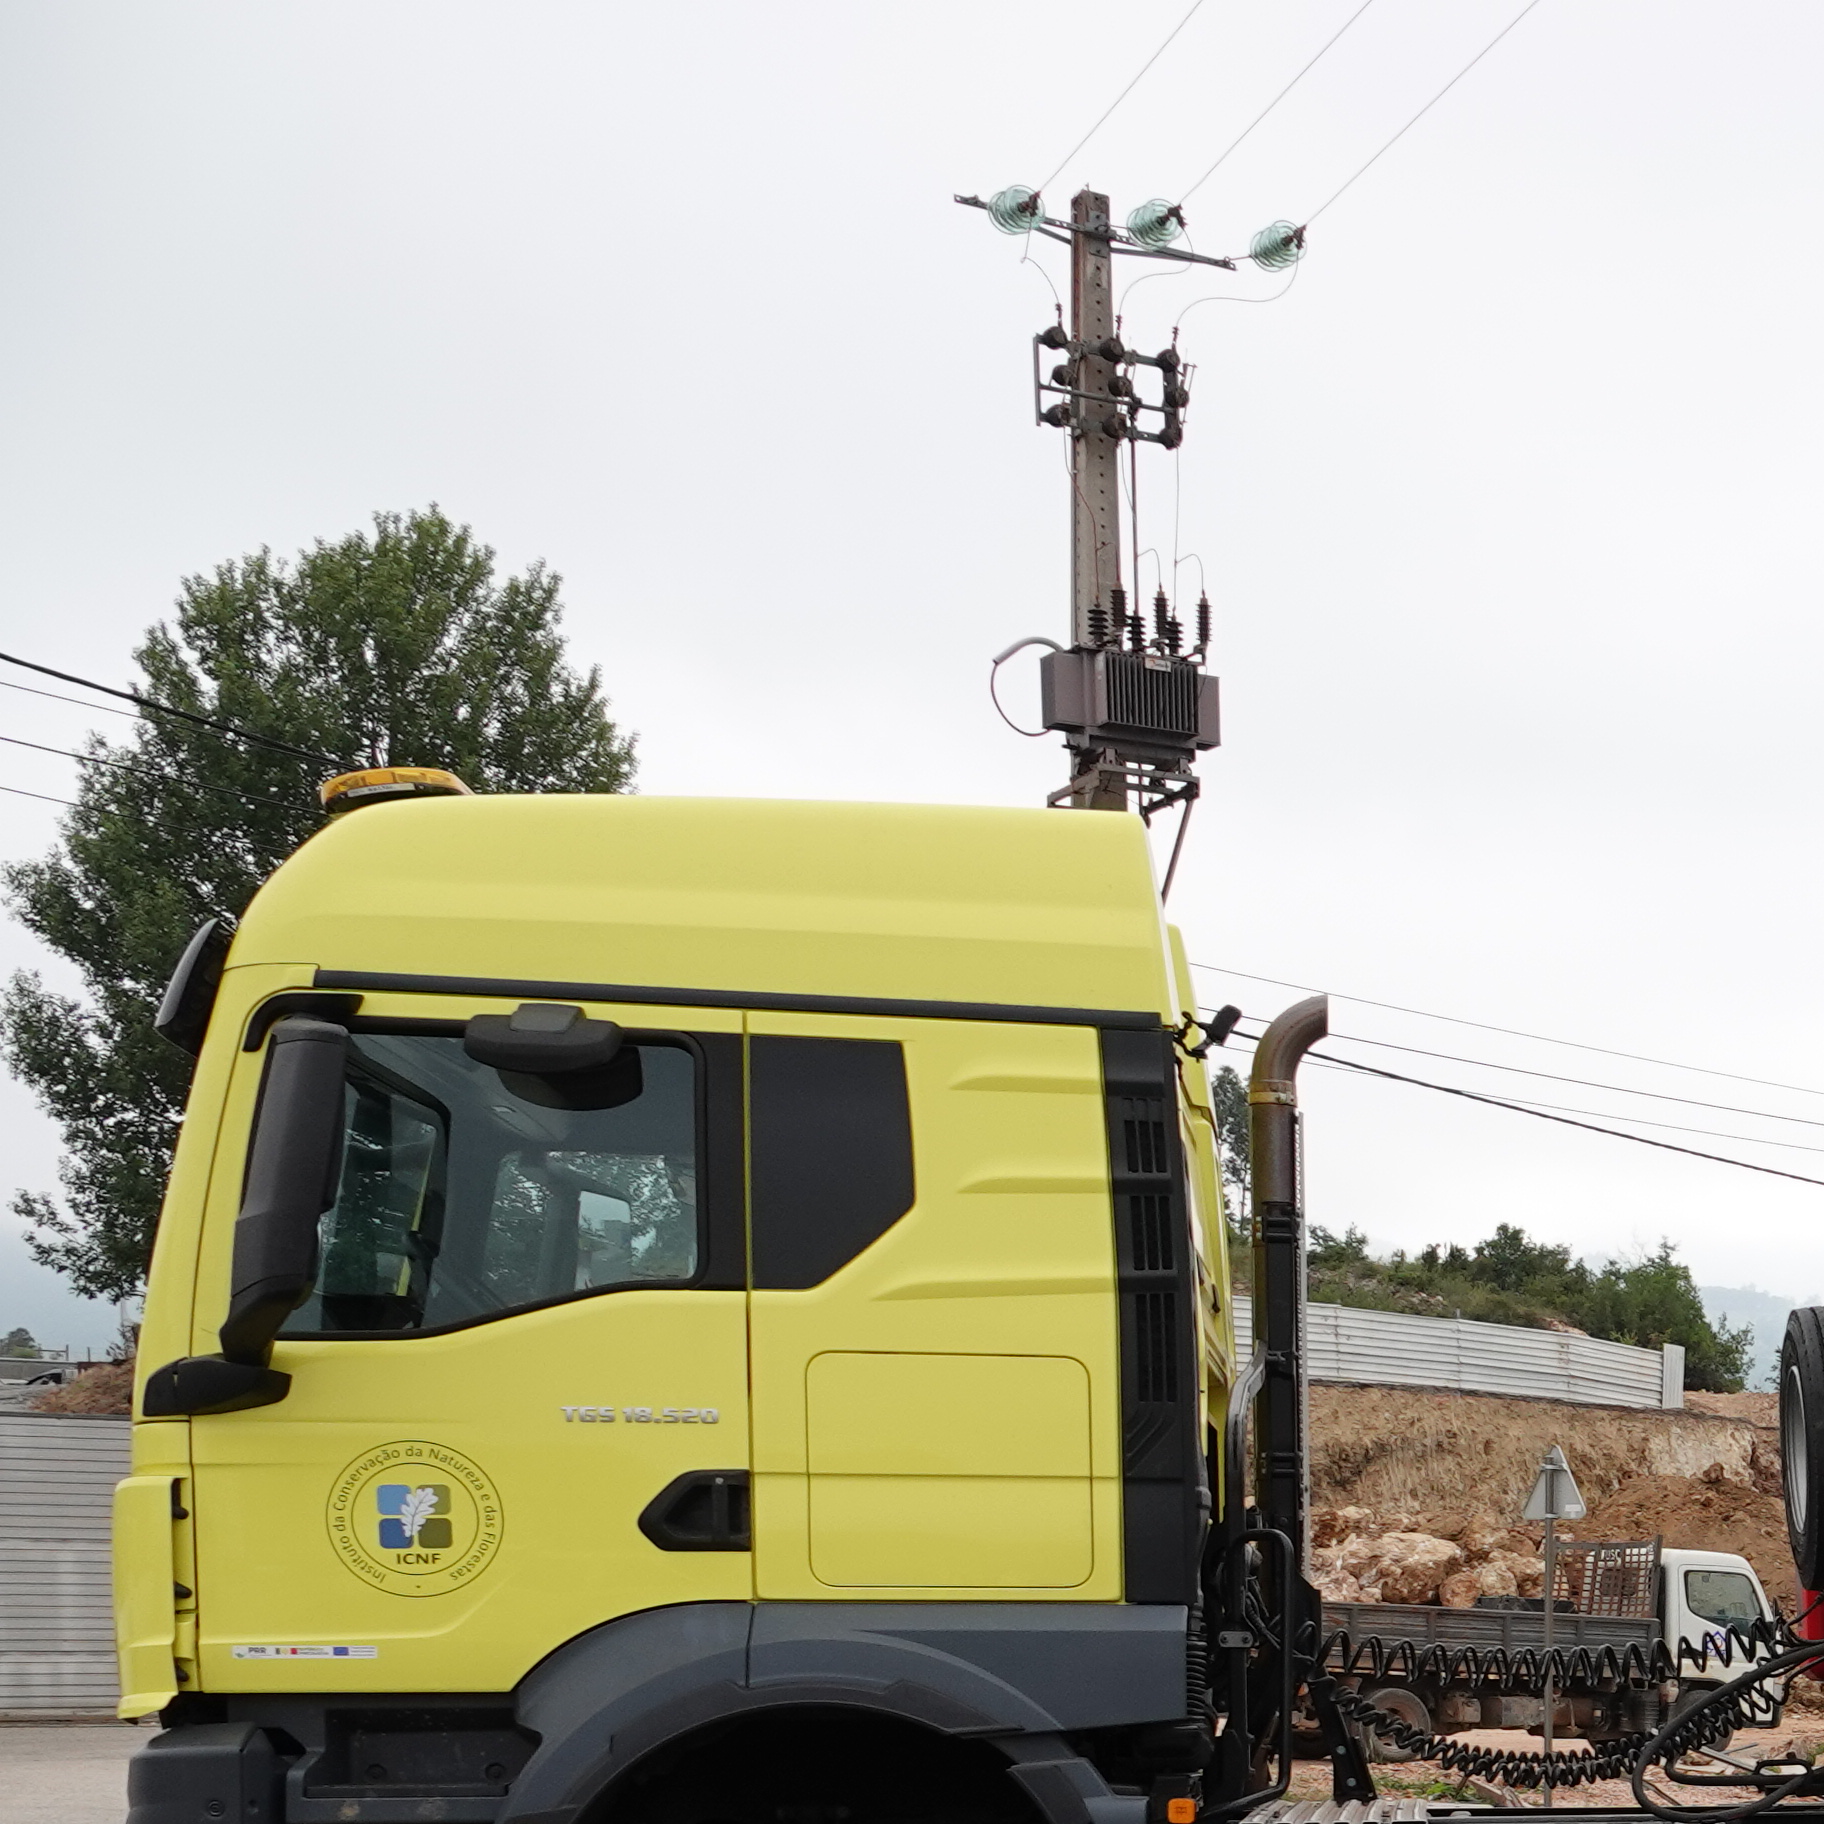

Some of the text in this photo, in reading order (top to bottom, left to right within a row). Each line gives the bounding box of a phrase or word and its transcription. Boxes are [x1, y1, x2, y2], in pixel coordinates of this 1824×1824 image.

[560, 1405, 719, 1424] TGS 18.520
[333, 1446, 498, 1584] Instituto da Conservação da Natureza e das Florestas
[396, 1553, 442, 1565] ICNF
